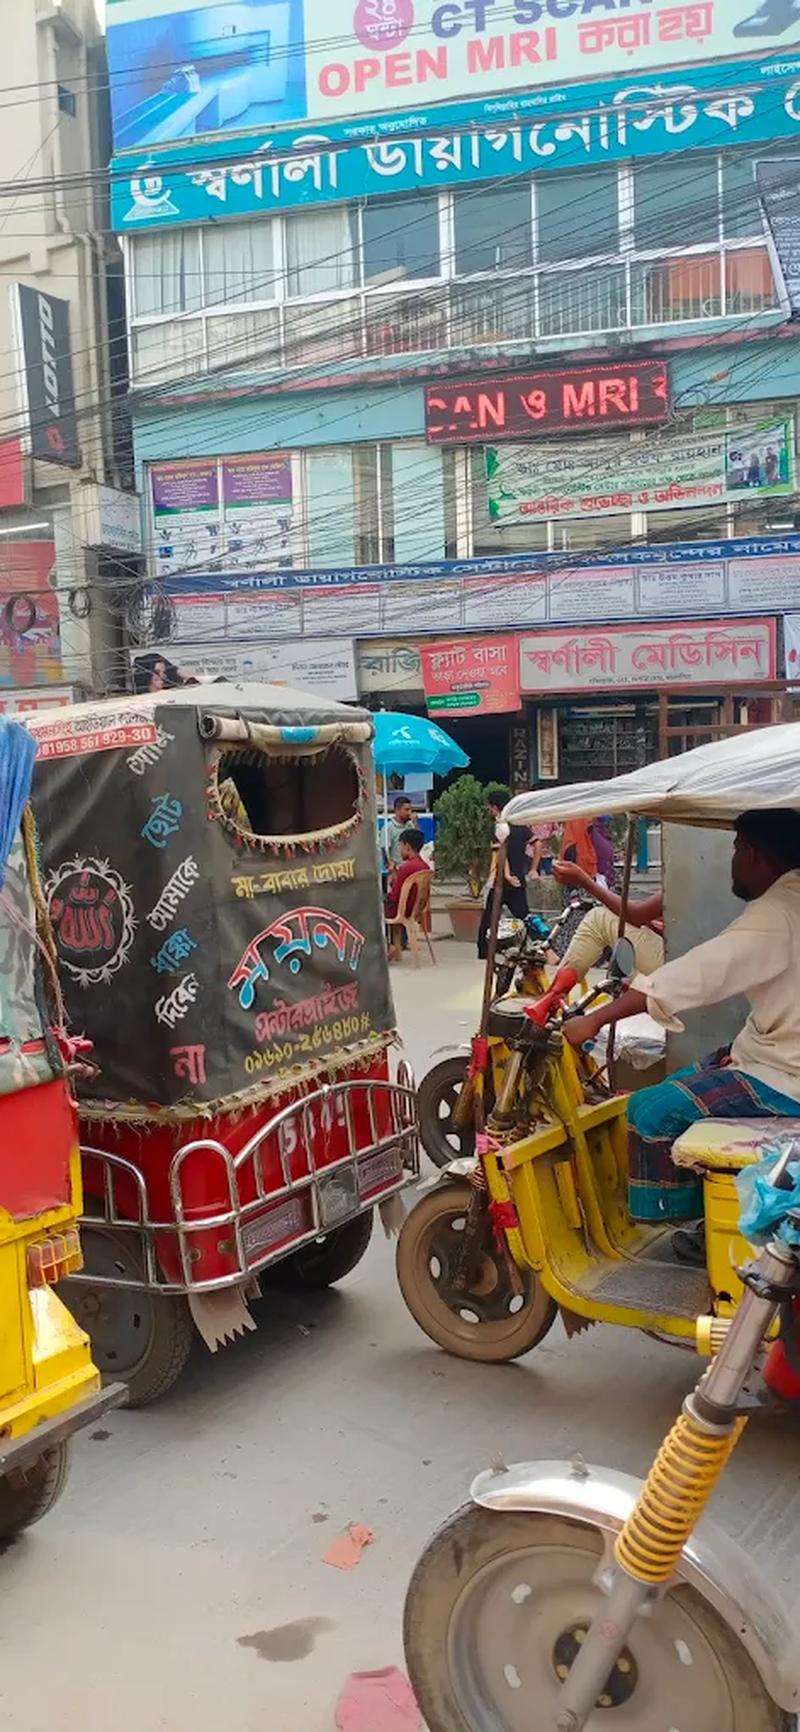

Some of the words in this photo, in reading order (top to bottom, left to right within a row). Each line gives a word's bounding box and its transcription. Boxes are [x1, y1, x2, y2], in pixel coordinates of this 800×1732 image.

[431, 0, 495, 38] CT
[511, 0, 651, 25] SC
[317, 46, 448, 98] OPEN
[466, 26, 557, 75] MRI
[577, 12, 651, 56] করা
[656, 2, 714, 44] হয়
[186, 134, 348, 202] স্বর্ণালী
[362, 80, 763, 176] ডায়াগনোস্টিক
[38, 293, 59, 419] LOTTO
[562, 376, 639, 417] MRI
[518, 494, 575, 515] আন্তরিক
[580, 492, 632, 512] শুভেচ্ছা
[638, 490, 649, 504] ও
[428, 645, 466, 671] ফ্ল্যাট
[472, 645, 507, 664] বাসা
[524, 635, 621, 677] স্বর্ণালী
[631, 629, 765, 672] মেডিসিন
[513, 727, 527, 782] RAZIN
[141, 792, 184, 849] ছোট
[146, 856, 201, 932] আমাকে
[312, 858, 357, 884] দোয়া
[149, 927, 198, 975] ধাক্কা
[227, 905, 365, 1010] ময়না
[154, 972, 200, 1030] দিবেন
[169, 1043, 207, 1085] না
